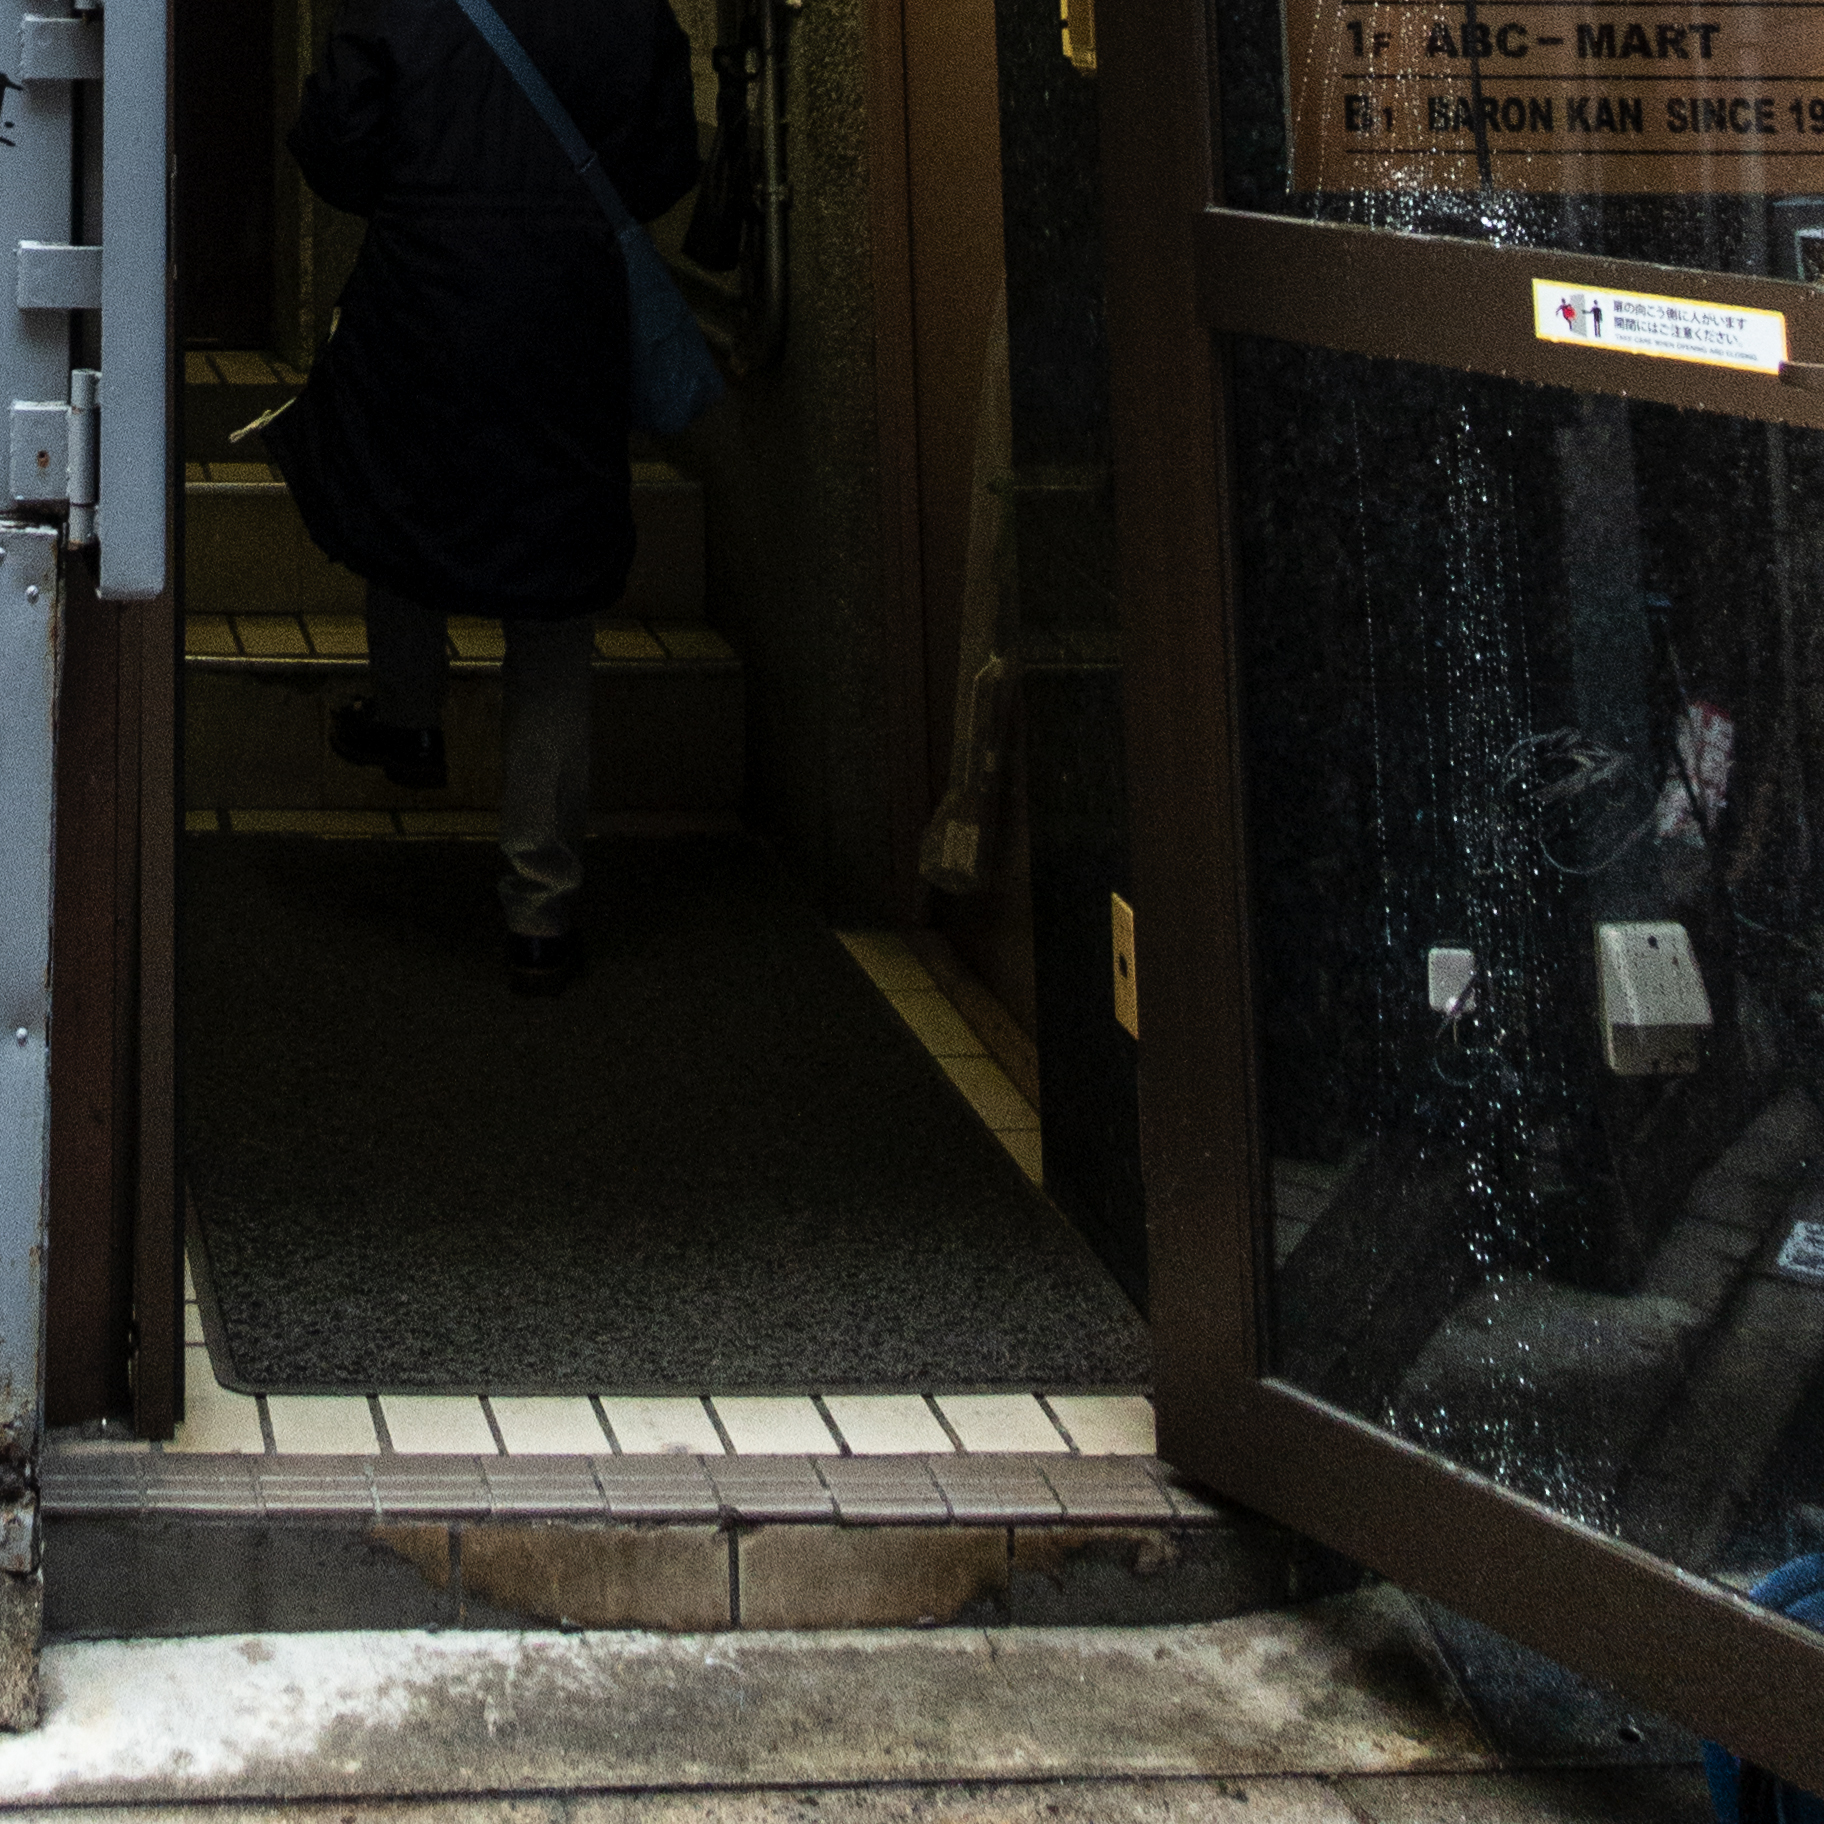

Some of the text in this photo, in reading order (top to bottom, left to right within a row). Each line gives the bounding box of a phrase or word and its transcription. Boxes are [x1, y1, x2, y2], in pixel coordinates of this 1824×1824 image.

[1345, 23, 1392, 58] 1F
[1429, 96, 1553, 133] BARON
[1567, 97, 1643, 133] KAN
[1667, 98, 1776, 134] SINCE
